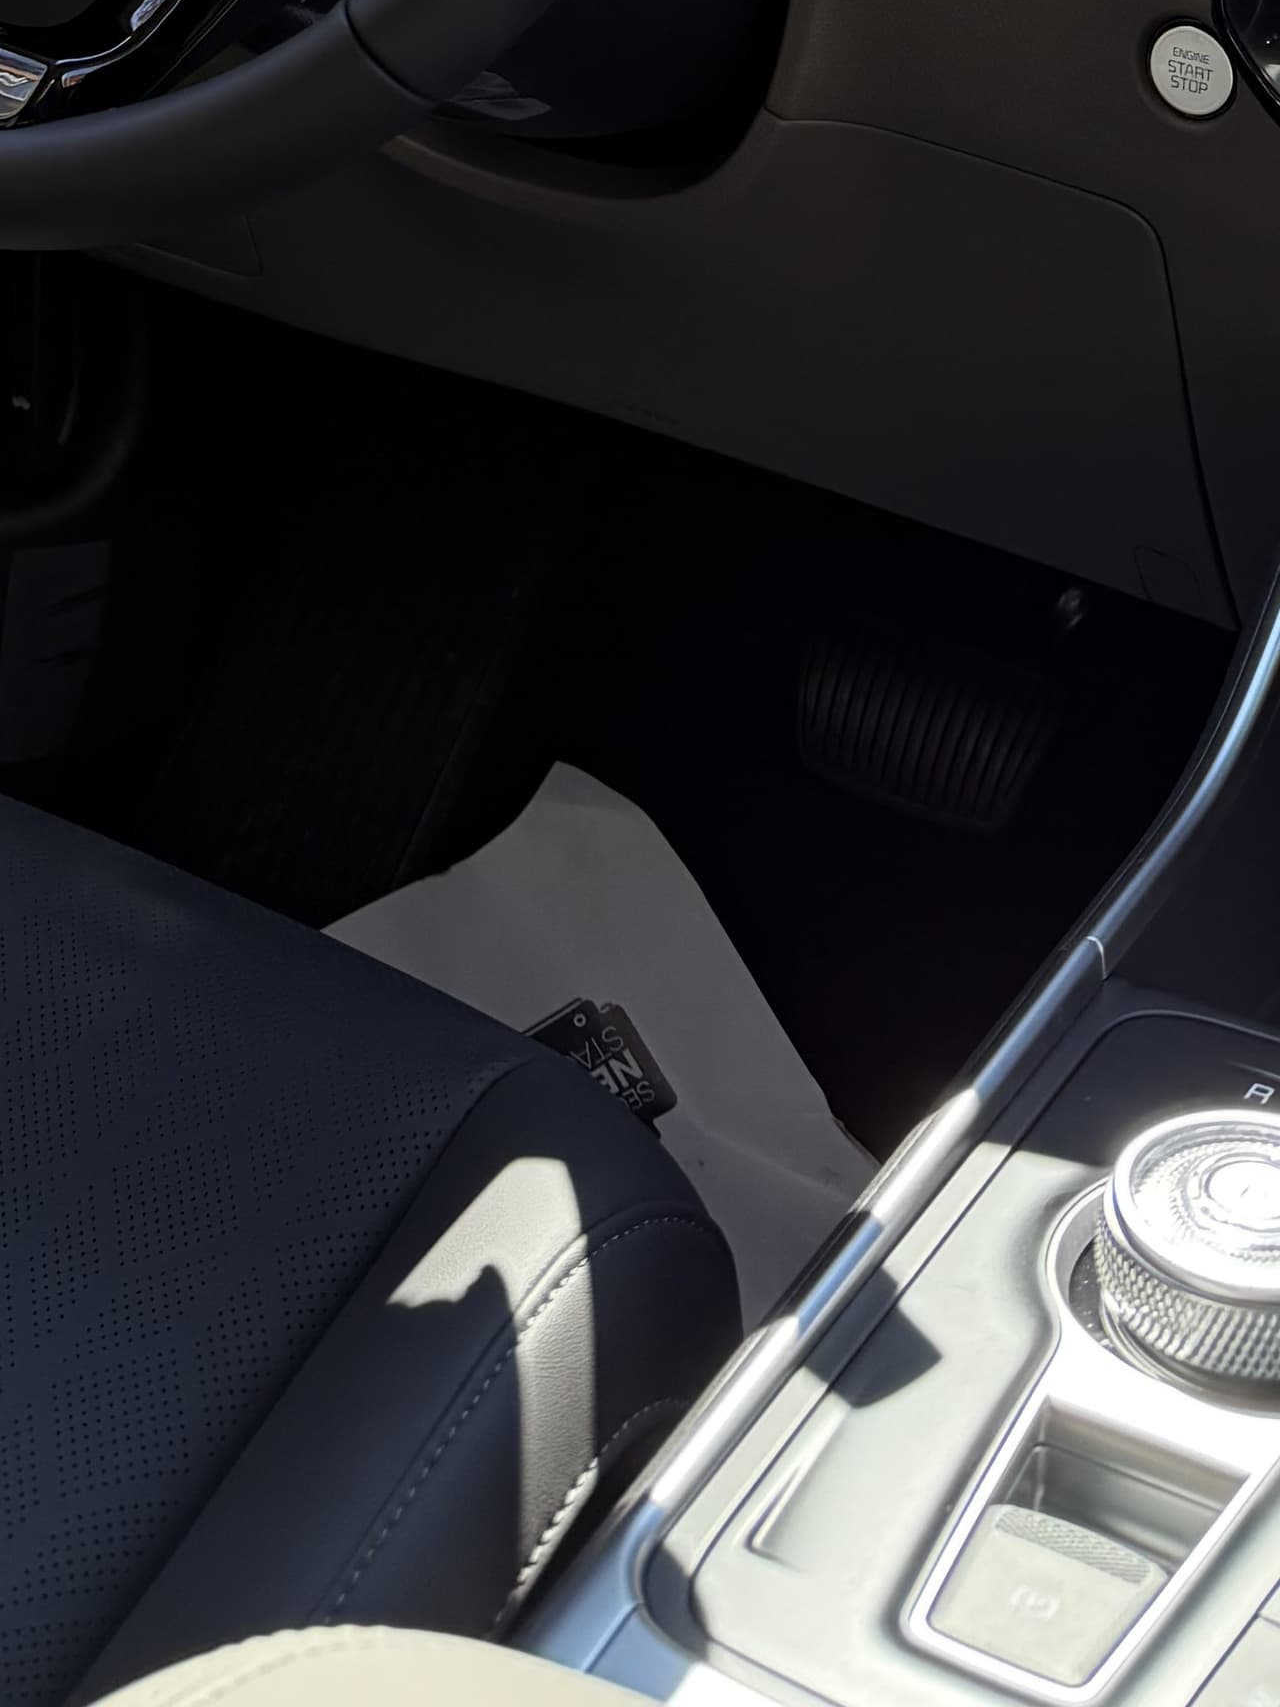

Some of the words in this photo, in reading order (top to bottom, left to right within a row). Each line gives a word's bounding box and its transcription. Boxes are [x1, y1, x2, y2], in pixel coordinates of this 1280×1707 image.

[1172, 46, 1211, 65] ENGINE
[1168, 59, 1214, 81] START
[1170, 75, 1209, 95] STOP
[1243, 1083, 1275, 1104] R
